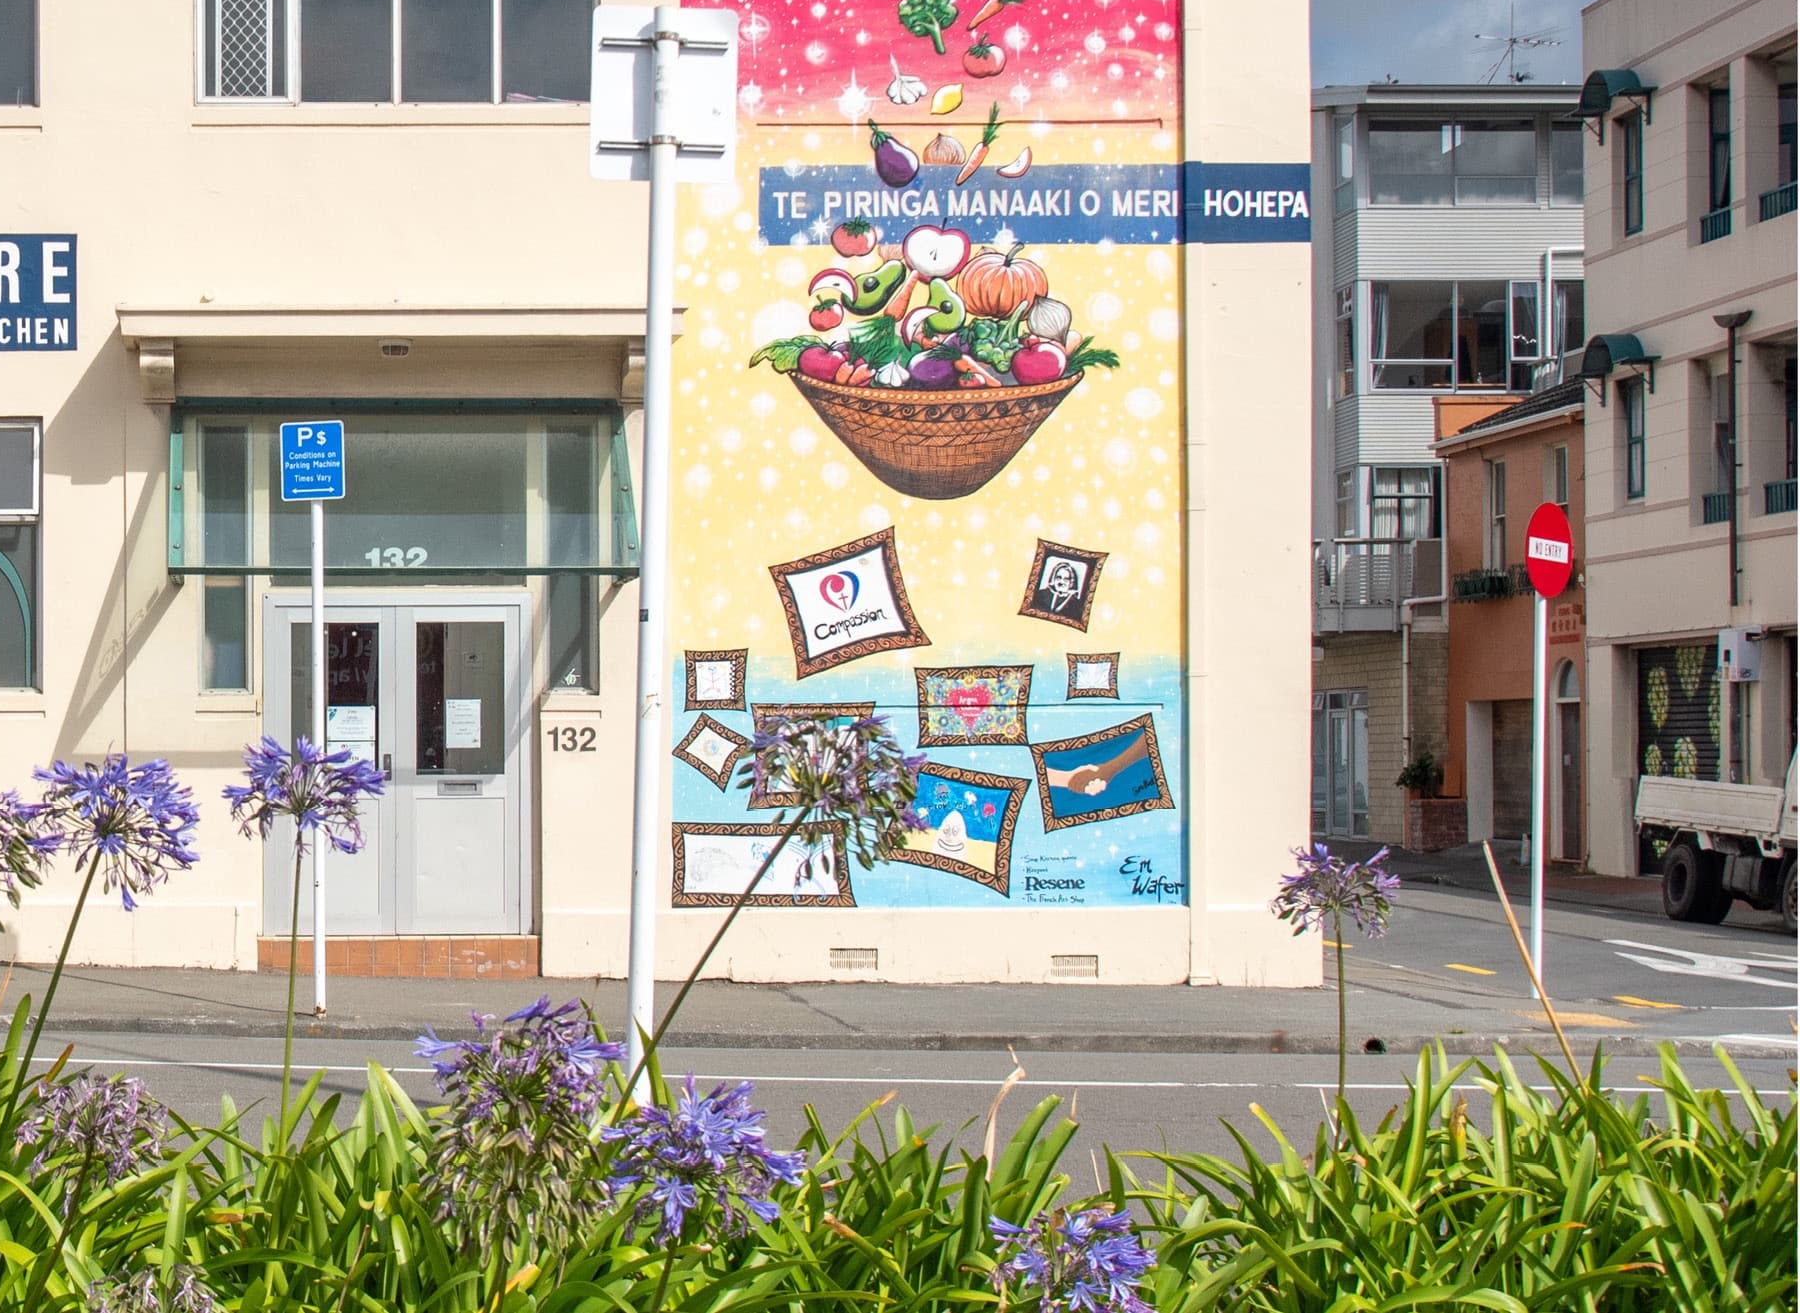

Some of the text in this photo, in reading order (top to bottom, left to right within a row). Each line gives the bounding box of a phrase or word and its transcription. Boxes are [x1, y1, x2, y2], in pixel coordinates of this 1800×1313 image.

[773, 189, 1310, 219] TE PIRINGA MANAAKI O MERI HOHEPA
[285, 460, 340, 470] Parking Machine
[289, 451, 325, 460] Conditions
[294, 473, 332, 483] Times Vary
[364, 547, 428, 568] 132
[1535, 542, 1562, 559] NO ENTRY
[814, 608, 887, 640] Compassion
[547, 726, 597, 752] 132
[1119, 855, 1152, 875] Em
[1024, 875, 1086, 891] Resene
[1131, 874, 1185, 903] Wafer
